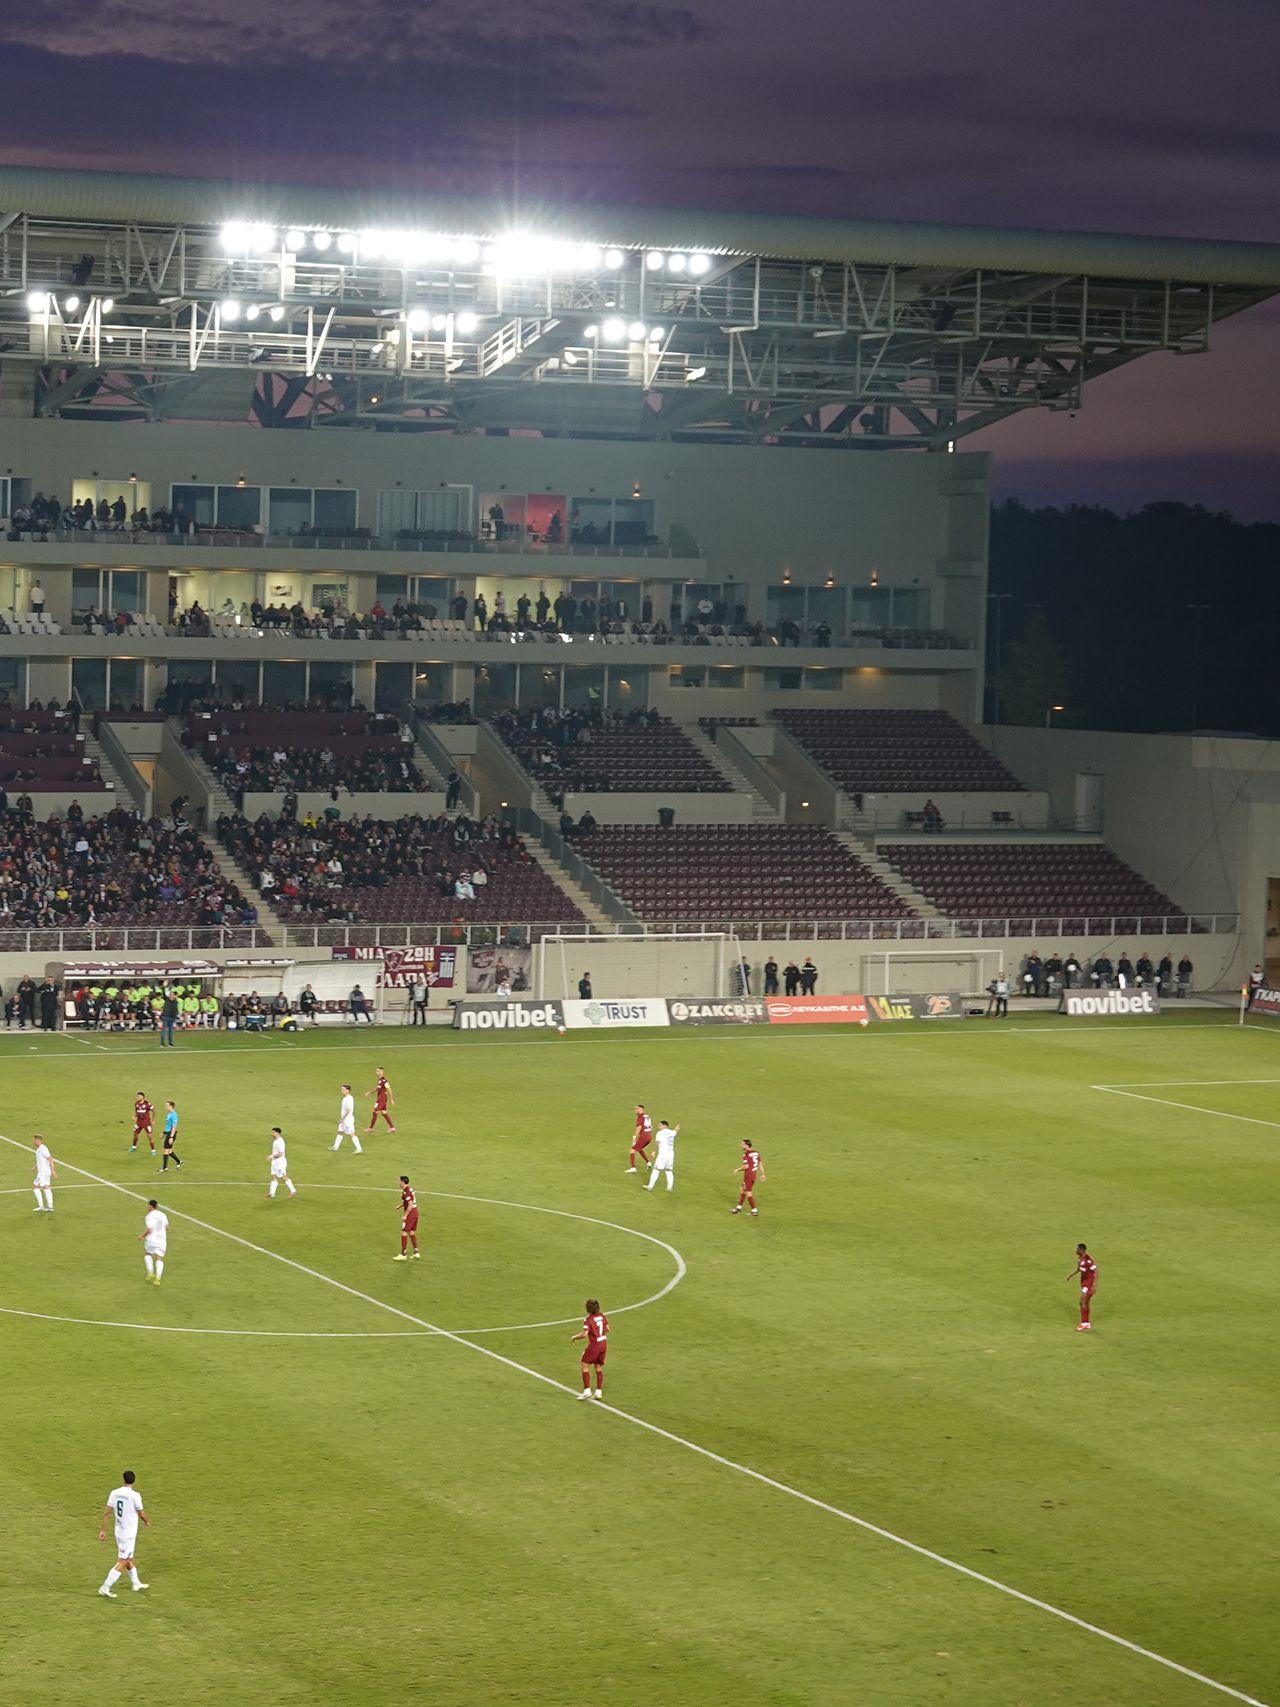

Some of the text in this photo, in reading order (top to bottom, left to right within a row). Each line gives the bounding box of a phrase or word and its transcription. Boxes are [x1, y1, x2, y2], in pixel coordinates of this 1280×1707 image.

[1068, 991, 1154, 1014] novibet
[460, 1003, 557, 1029] novibet
[116, 1500, 124, 1517] 6
